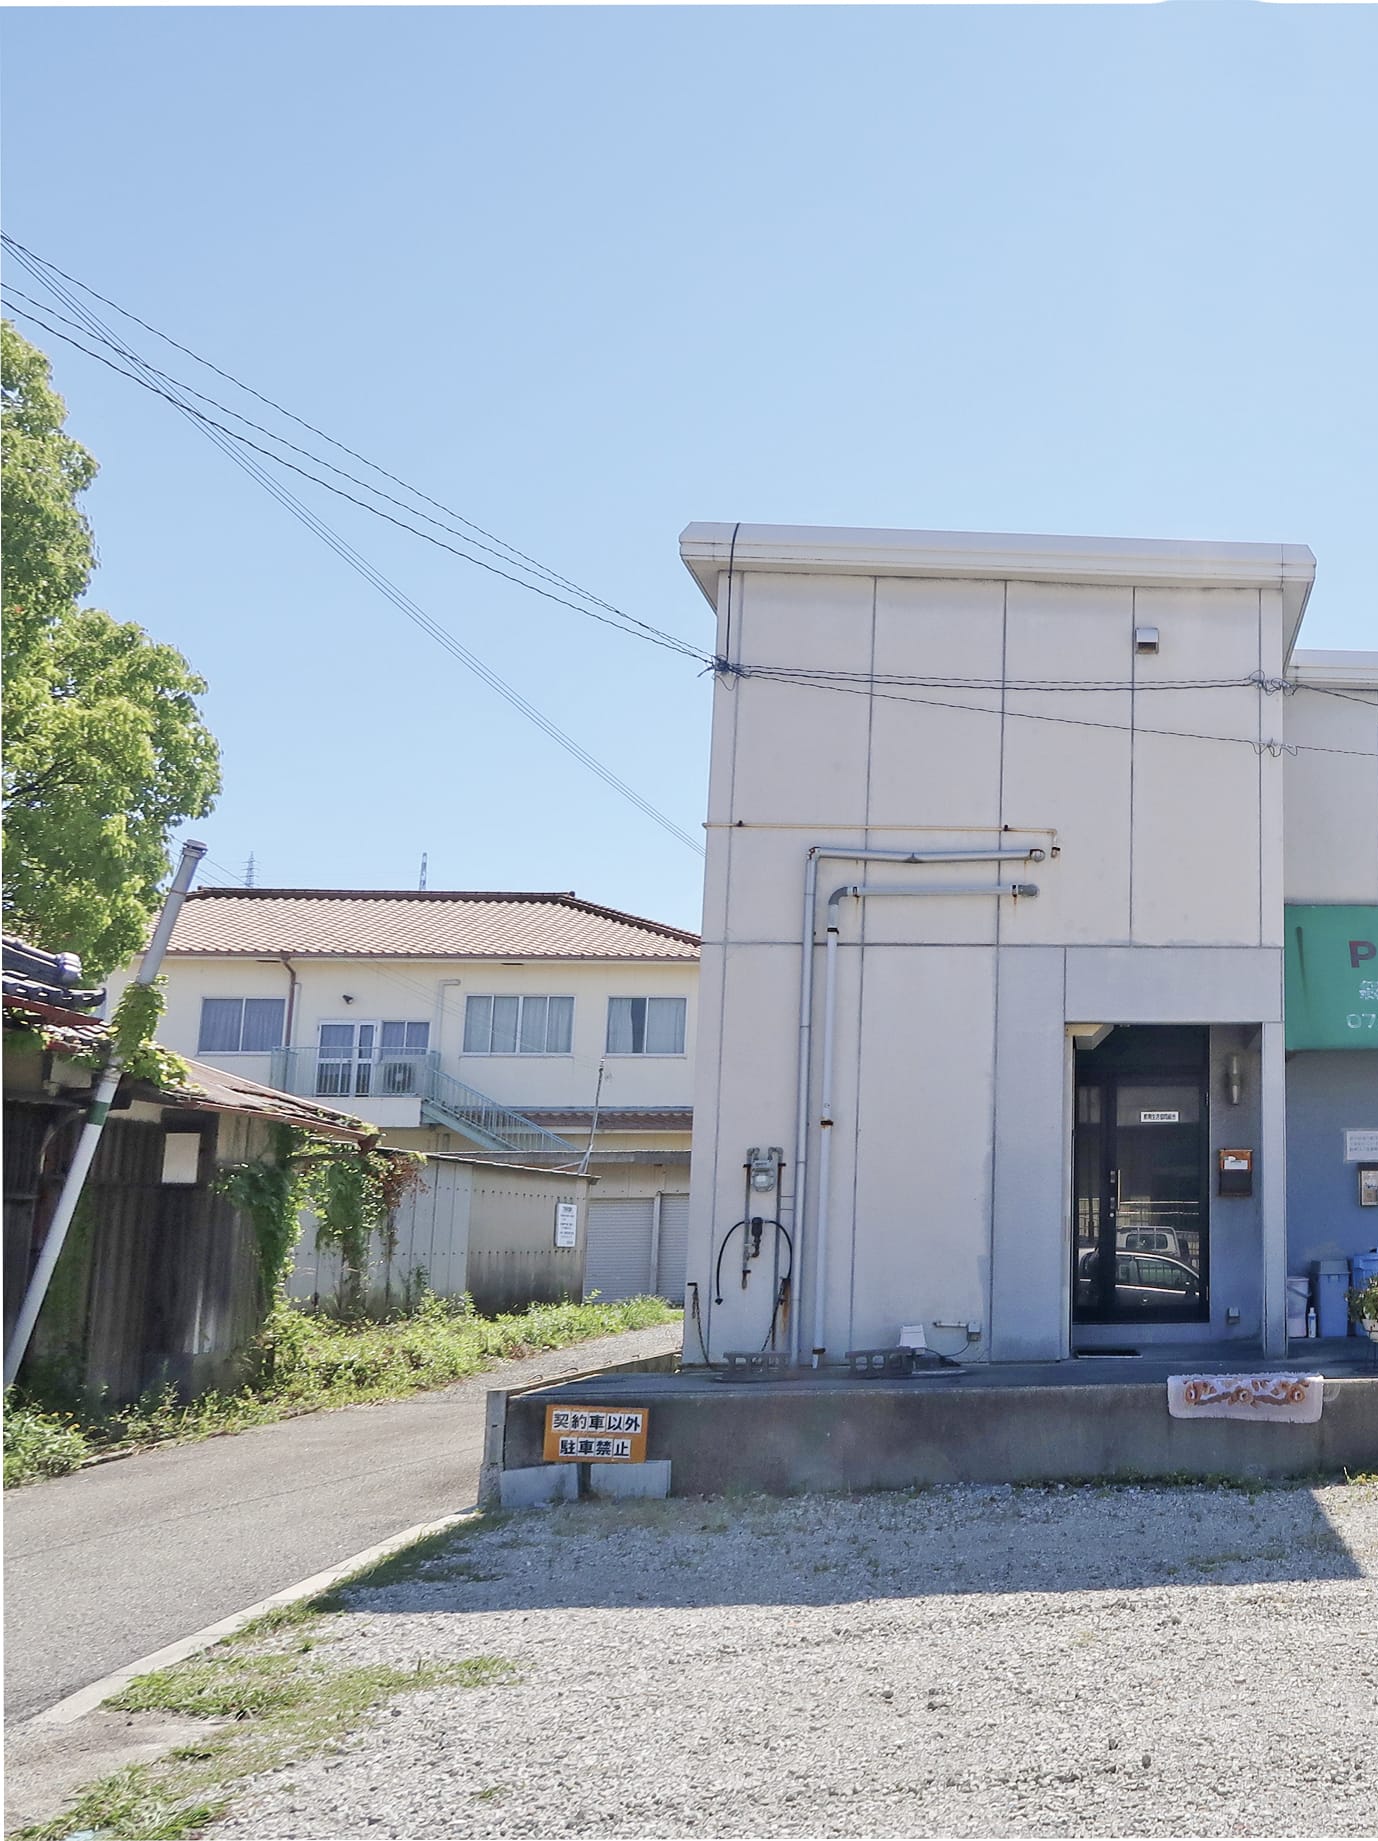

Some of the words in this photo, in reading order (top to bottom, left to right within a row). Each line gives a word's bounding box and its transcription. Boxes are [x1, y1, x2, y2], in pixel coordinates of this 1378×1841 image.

[553, 1412, 641, 1432] 契約車以外
[560, 1439, 630, 1458] 駐車禁止
